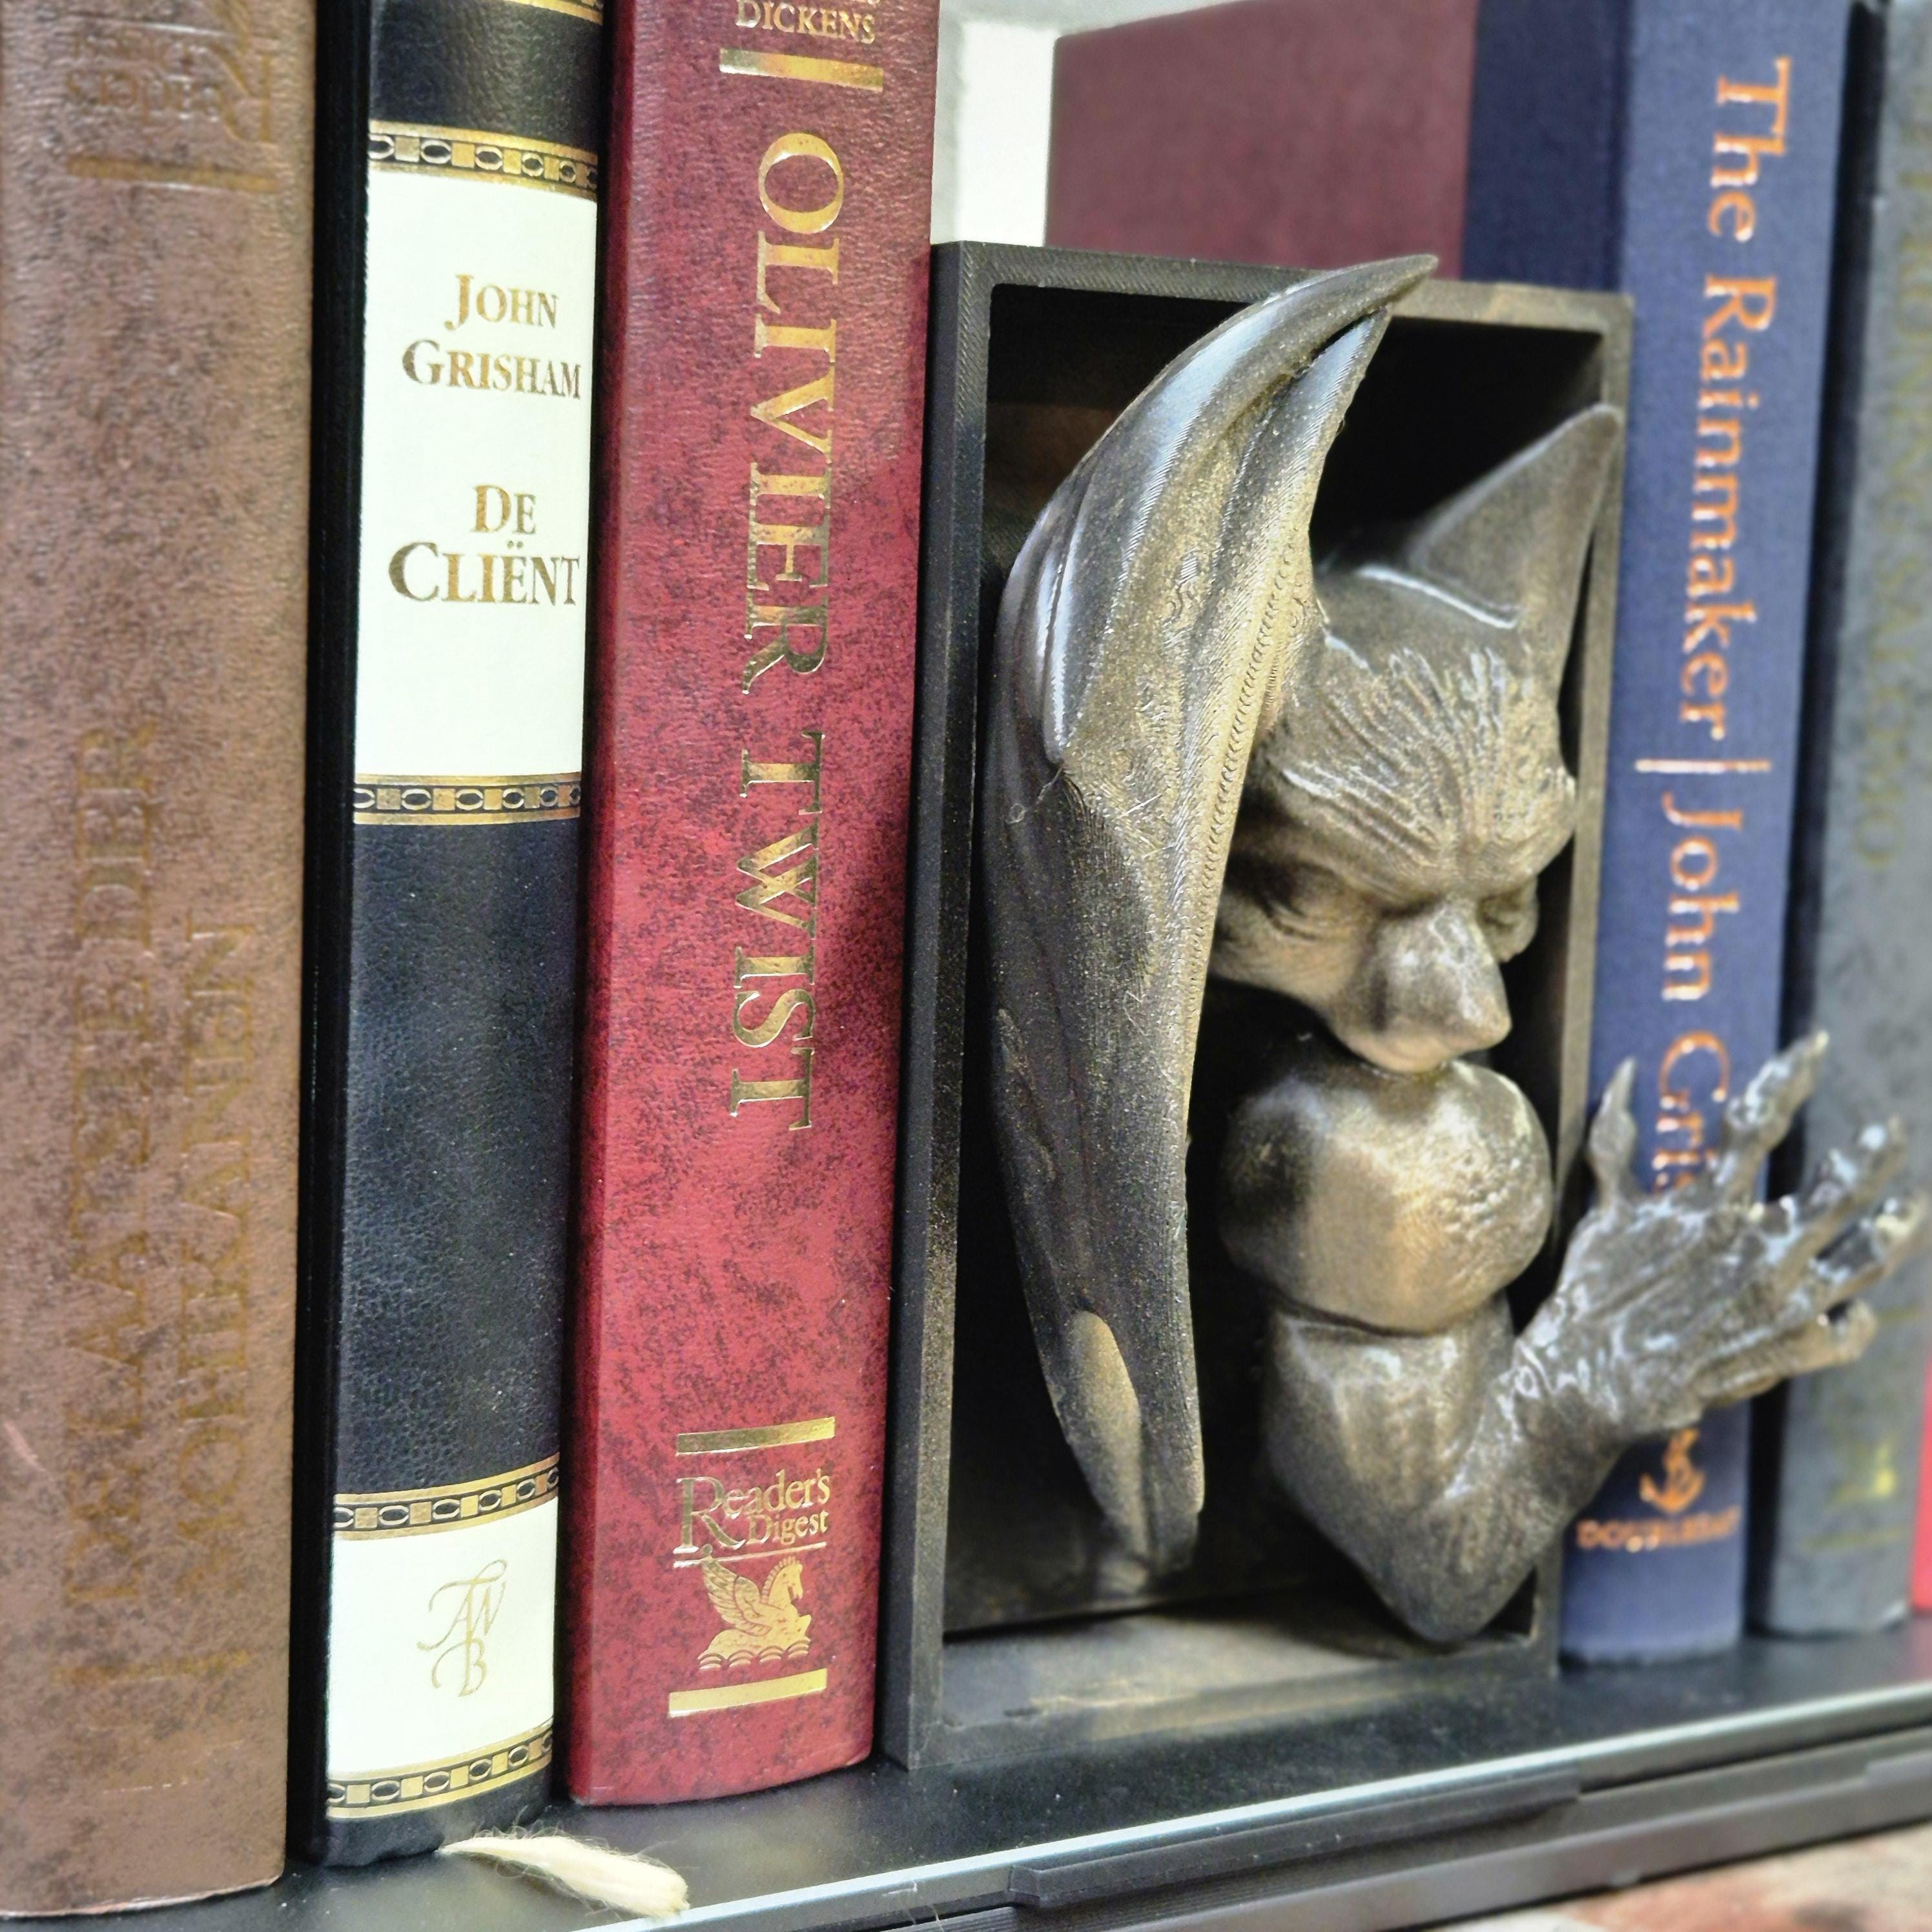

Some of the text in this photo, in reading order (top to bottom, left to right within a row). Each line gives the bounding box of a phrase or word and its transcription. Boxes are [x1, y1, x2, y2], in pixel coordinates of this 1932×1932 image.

[734, 0, 875, 44] DICKENS
[1706, 54, 1793, 243] The
[443, 274, 560, 331] JOHN
[401, 339, 582, 400] GRISHAM
[470, 484, 537, 535] DE
[1680, 274, 1777, 741] Rainmaker
[388, 540, 581, 606] CLIËNT
[729, 131, 844, 1131] OLIVIER TWIST
[1661, 790, 1745, 1002] John
[672, 1468, 831, 1555] Reader's
[745, 1510, 830, 1546] Digest
